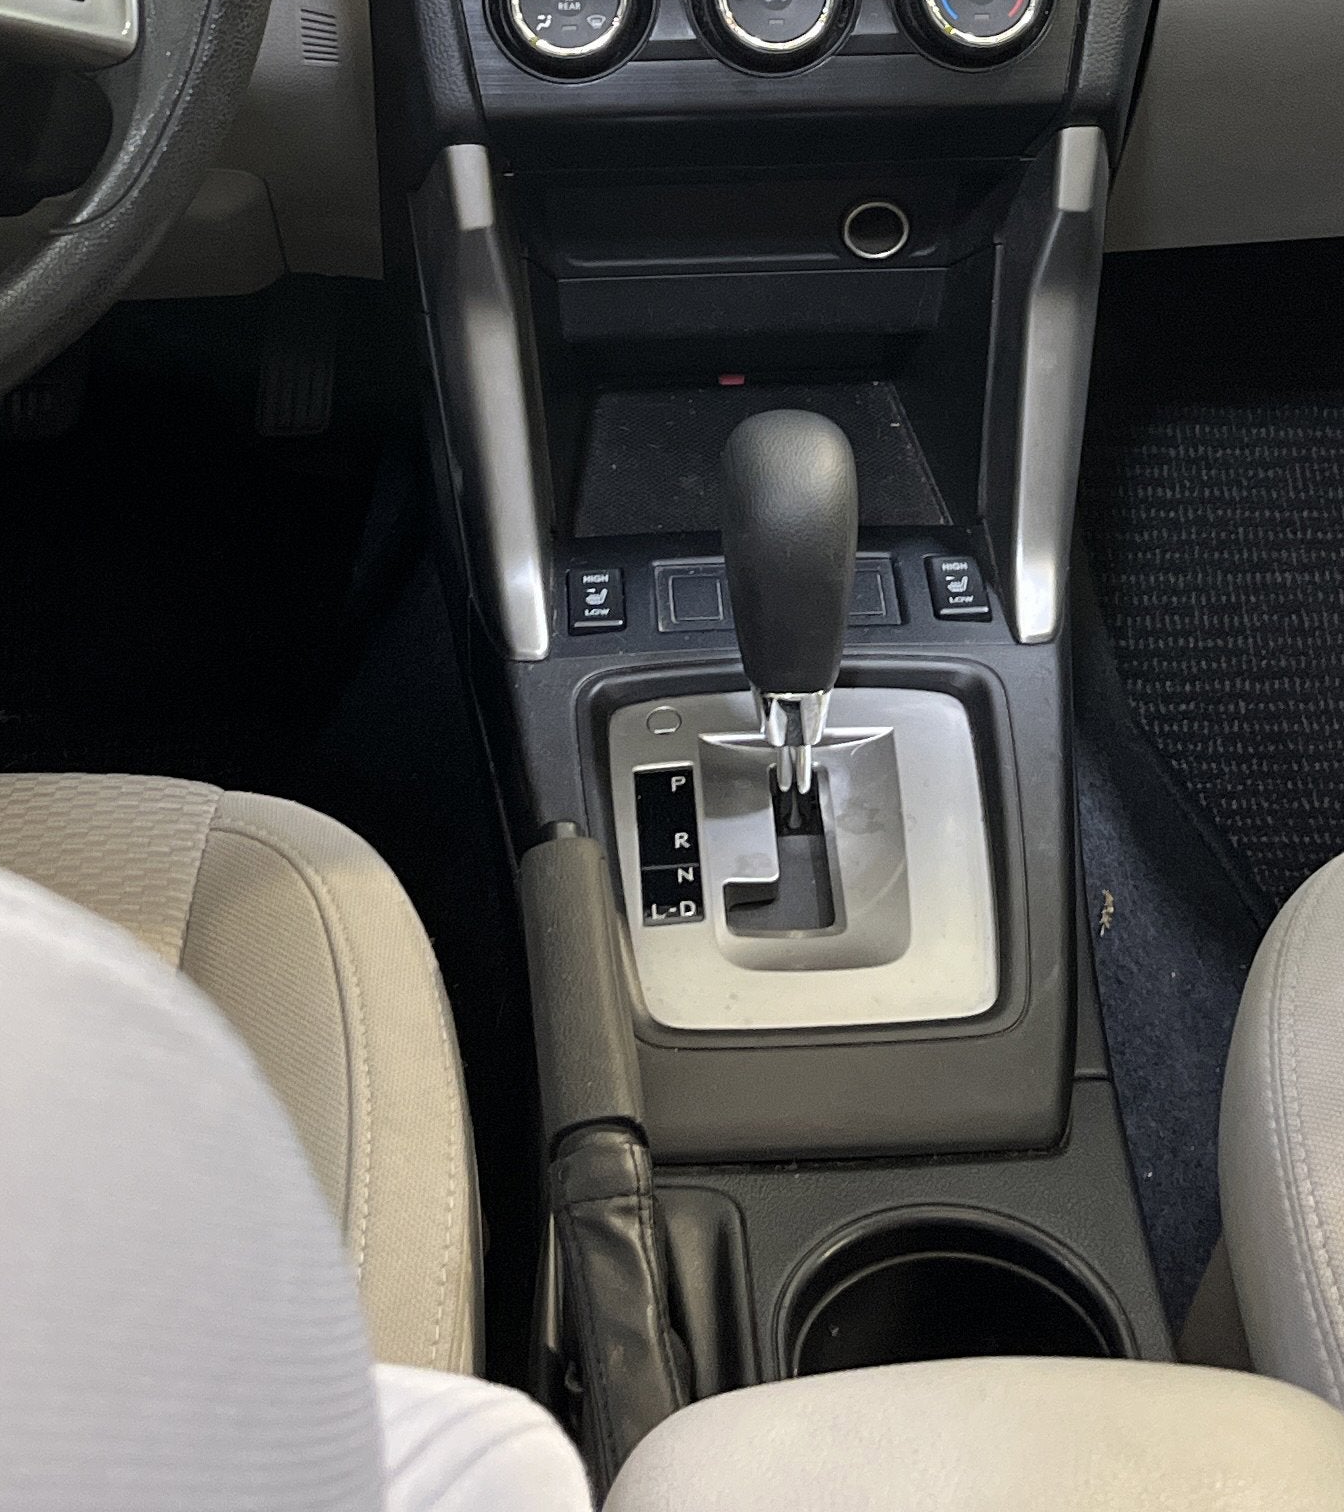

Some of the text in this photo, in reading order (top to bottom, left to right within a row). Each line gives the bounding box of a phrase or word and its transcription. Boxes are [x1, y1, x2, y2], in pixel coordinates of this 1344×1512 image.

[558, 0, 581, 11] REAR
[942, 562, 969, 571] HIGH
[582, 574, 609, 584] HIGH
[948, 595, 974, 604] LOW
[584, 608, 611, 617] LOW
[670, 776, 687, 792] P
[674, 832, 691, 849] R
[677, 866, 694, 883] N
